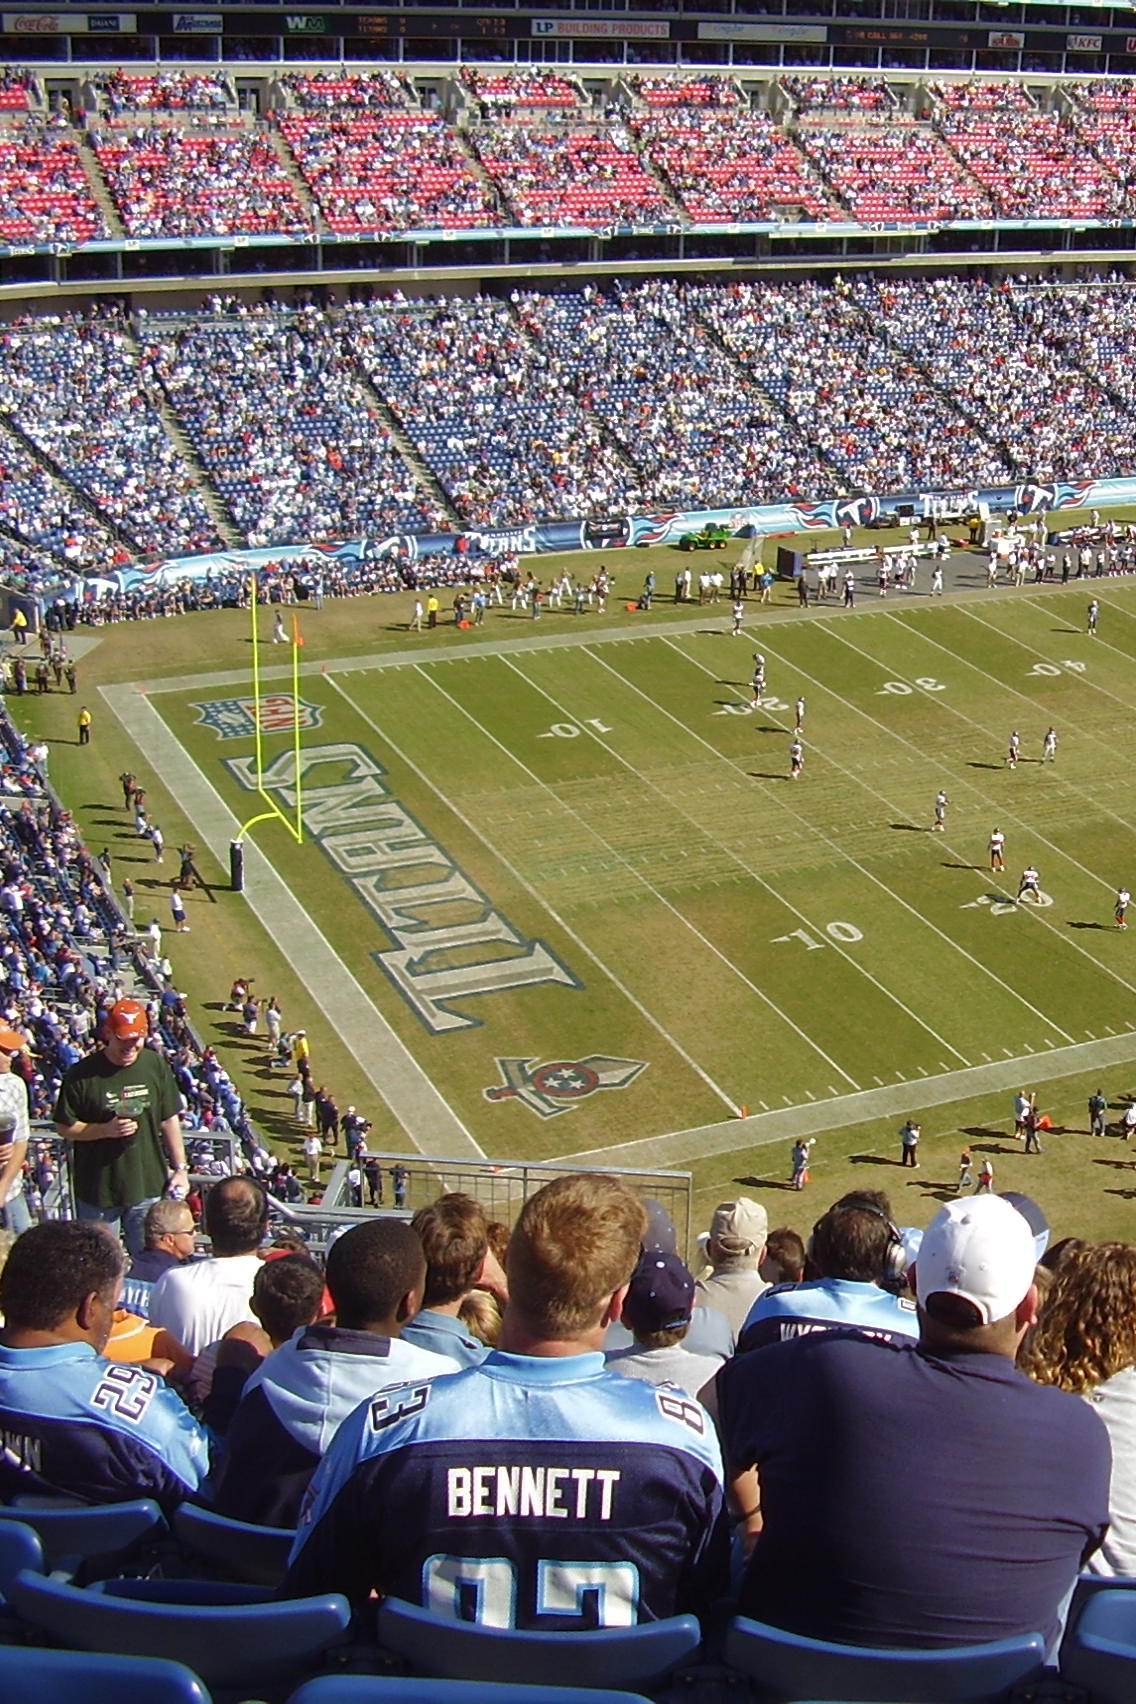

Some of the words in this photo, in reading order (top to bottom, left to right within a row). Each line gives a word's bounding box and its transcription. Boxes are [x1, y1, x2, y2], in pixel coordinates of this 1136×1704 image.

[536, 22, 553, 33] LP
[557, 22, 608, 34] BUILDING
[612, 23, 667, 35] PRODUCTS
[1078, 38, 1100, 48] KFC
[549, 718, 614, 739] 10
[789, 921, 864, 950] 10
[90, 1364, 158, 1425] 29
[0, 1429, 42, 1473] WN
[448, 1466, 621, 1521] BENNETT
